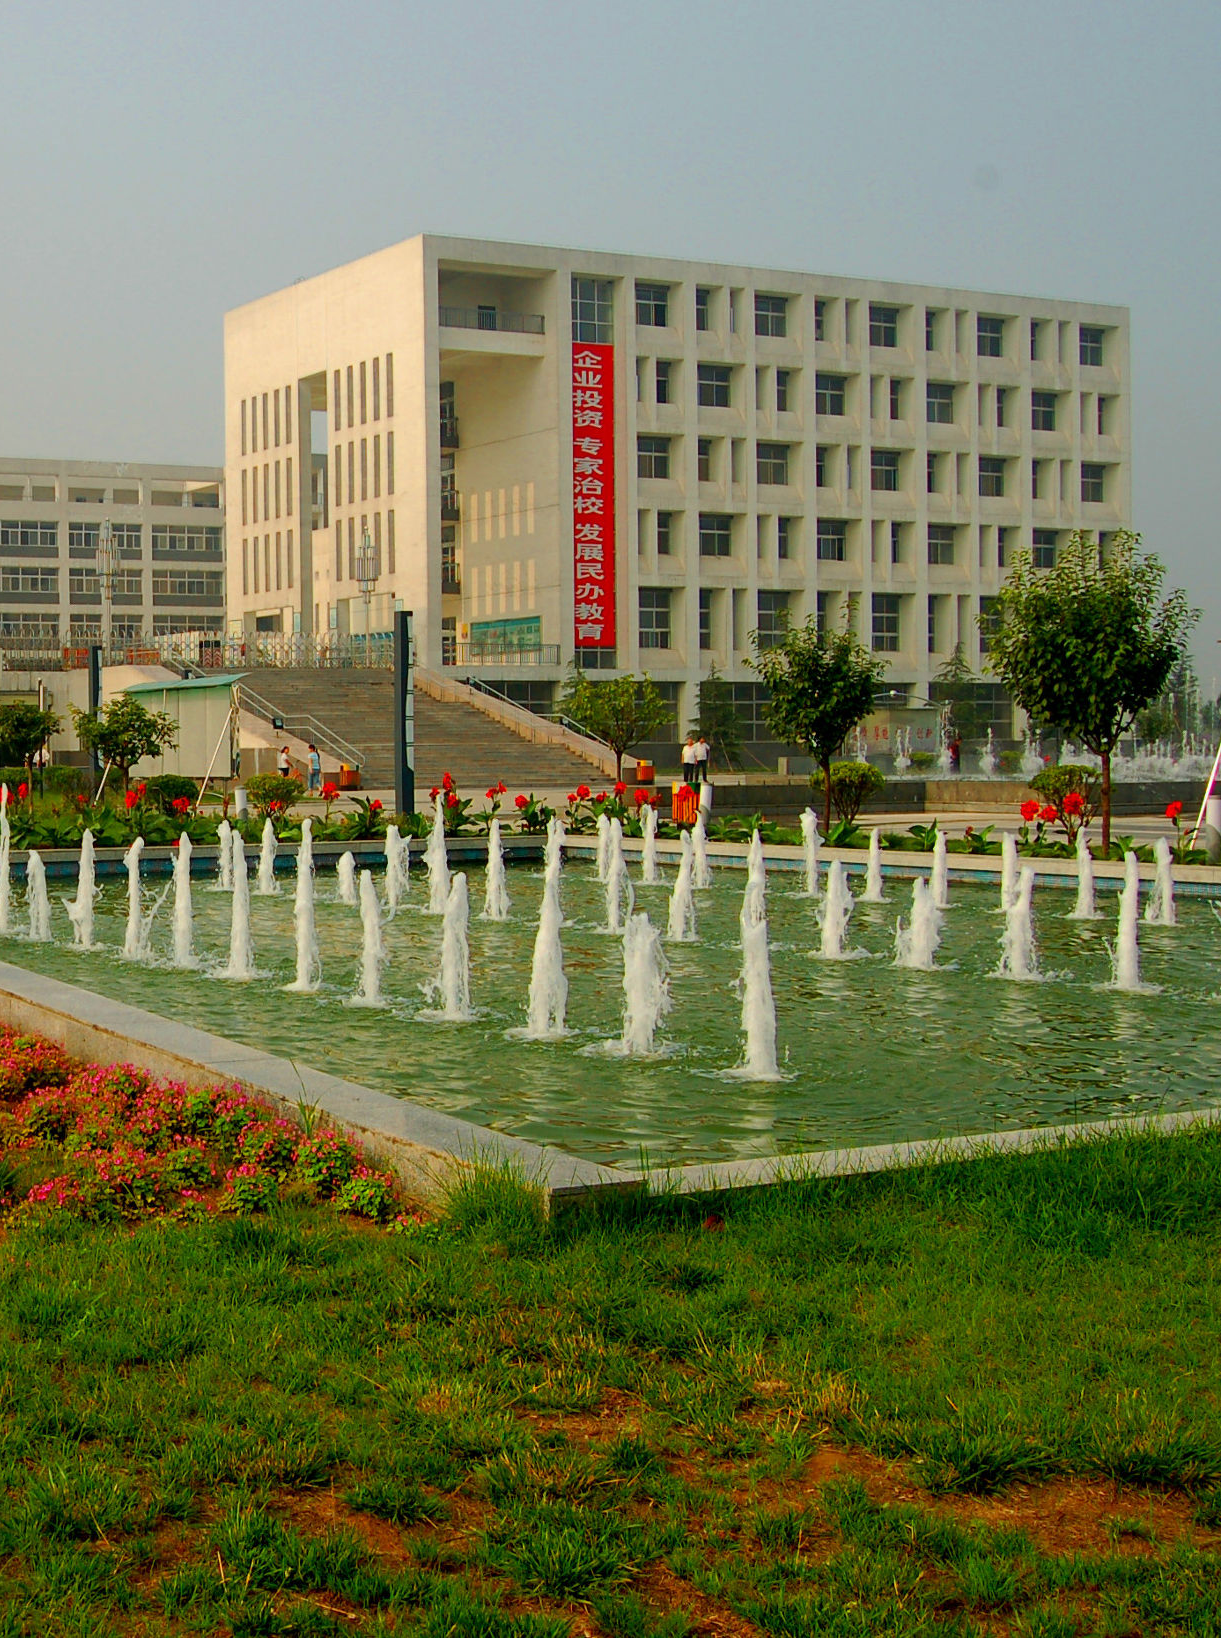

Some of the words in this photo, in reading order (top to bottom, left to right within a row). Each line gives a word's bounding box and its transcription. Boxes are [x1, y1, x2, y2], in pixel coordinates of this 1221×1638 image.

[573, 350, 603, 429] 企业投资
[573, 437, 604, 515] 专家治校
[574, 523, 605, 640] 发展民办教育
